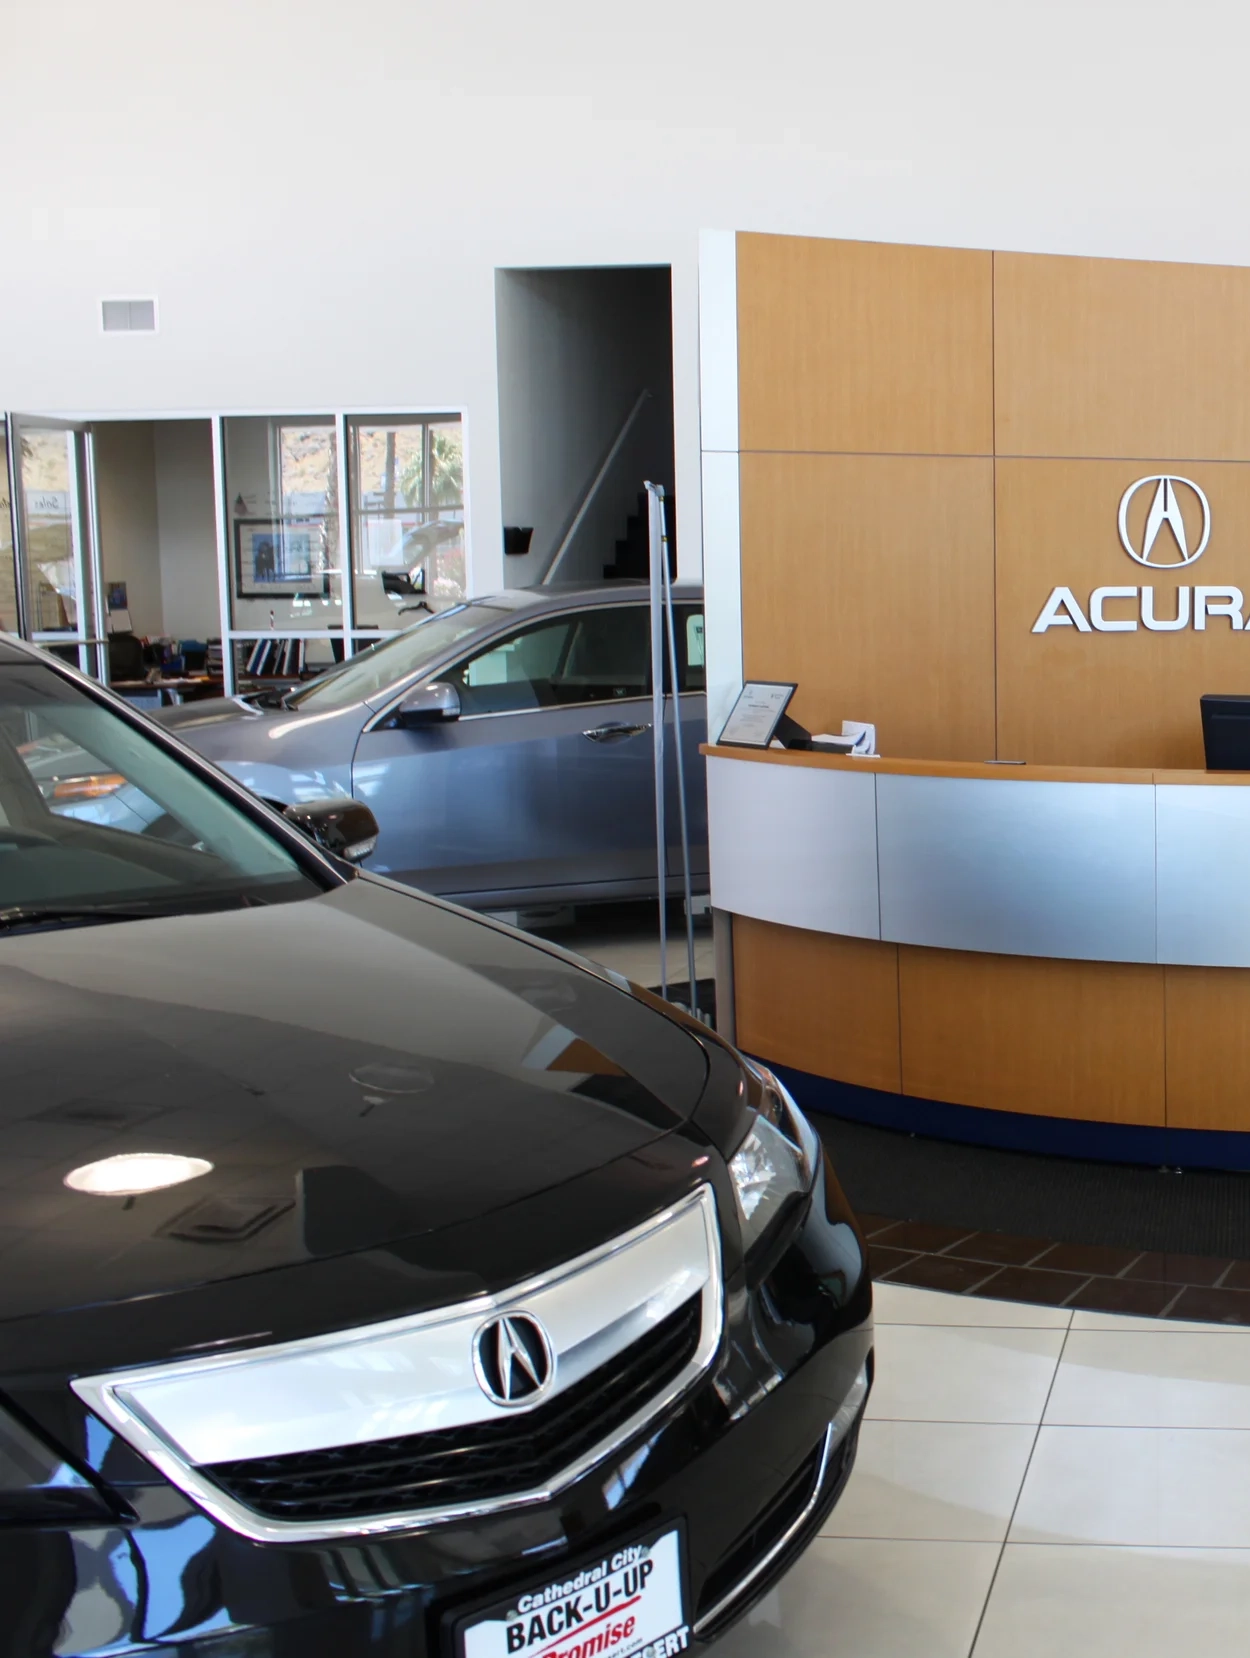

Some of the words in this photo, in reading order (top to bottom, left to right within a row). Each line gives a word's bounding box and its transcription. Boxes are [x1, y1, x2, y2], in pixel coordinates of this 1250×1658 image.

[506, 1559, 654, 1655] BACK-U-UP
[517, 1560, 608, 1613] Cathedral
[611, 1545, 643, 1572] City
[542, 1616, 636, 1658] omise
